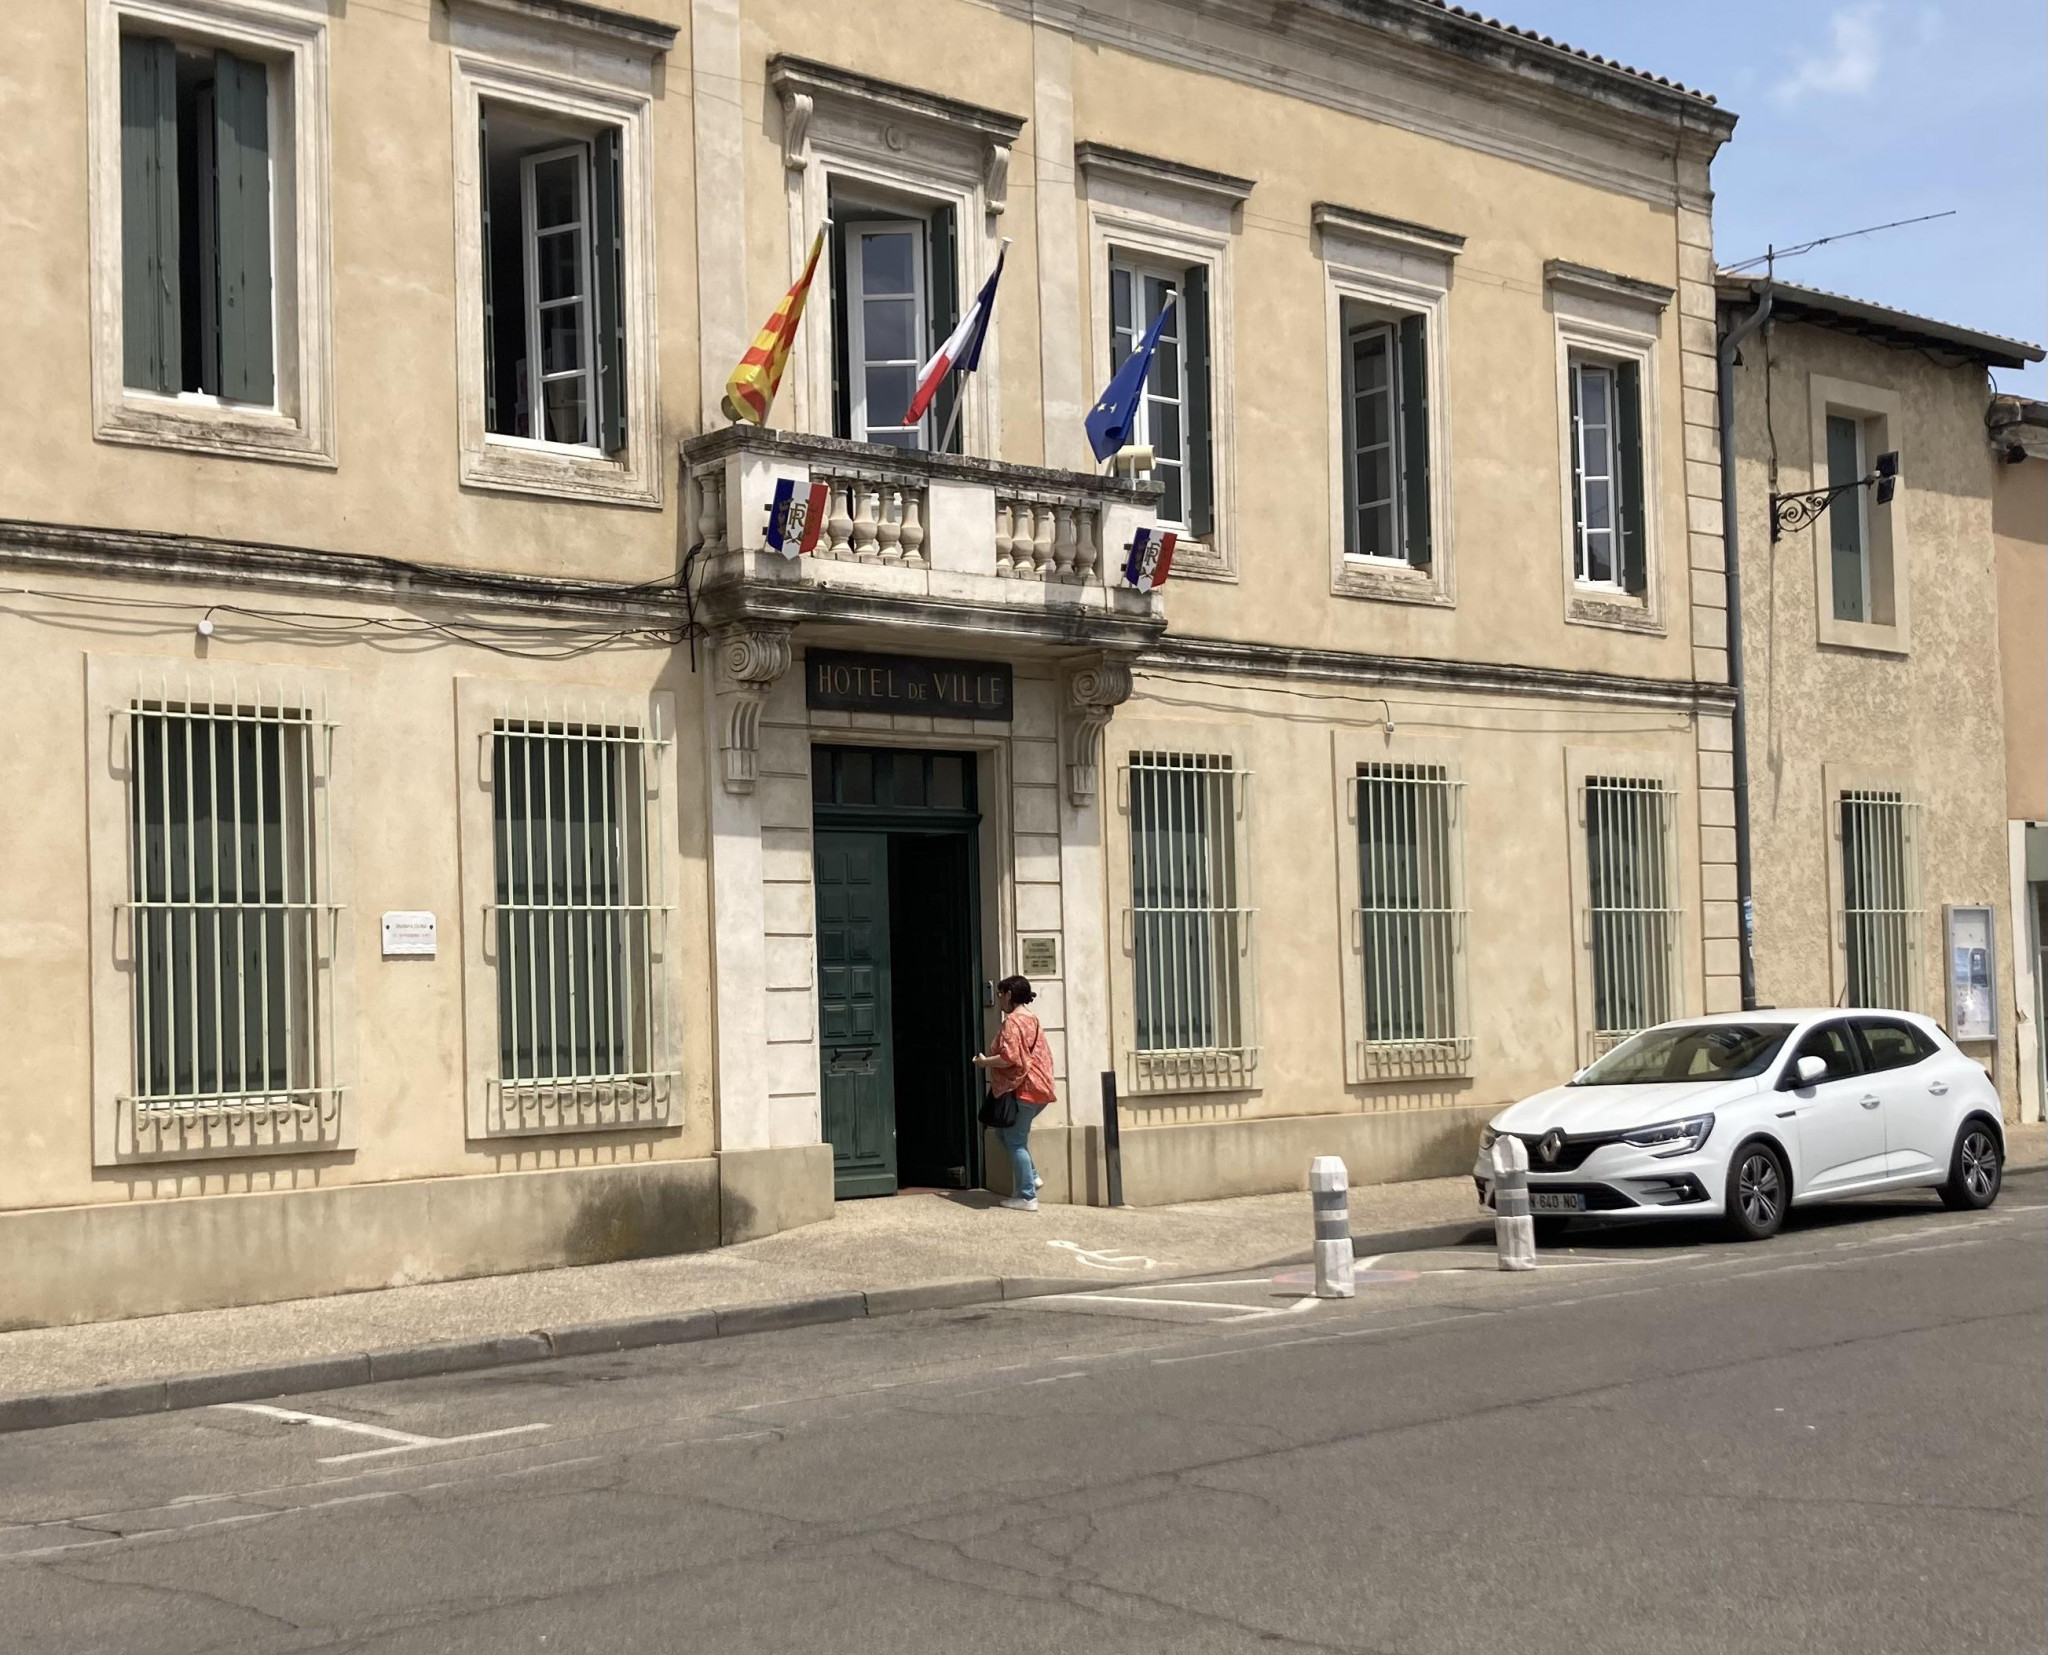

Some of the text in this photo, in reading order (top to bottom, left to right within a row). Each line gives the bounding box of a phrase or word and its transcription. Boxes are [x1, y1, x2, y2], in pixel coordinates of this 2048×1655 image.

[819, 665, 1003, 704] HOTEL DE VILLE
